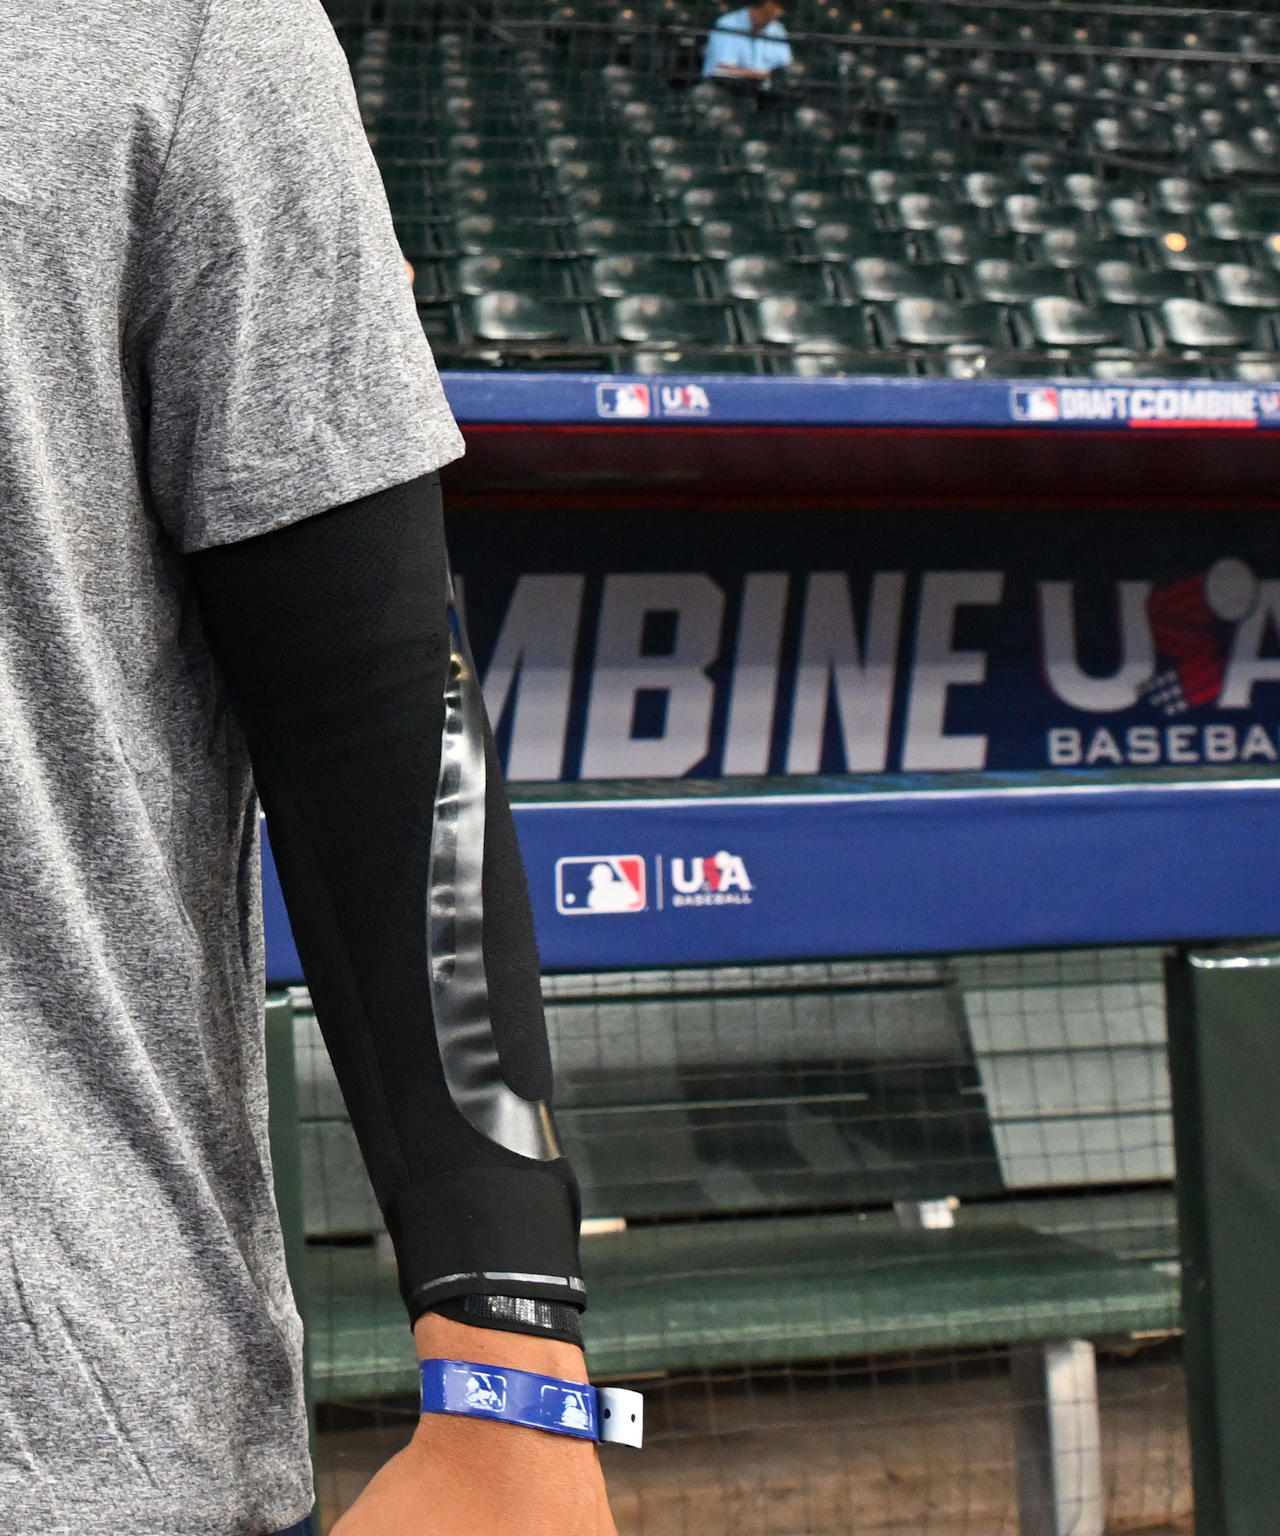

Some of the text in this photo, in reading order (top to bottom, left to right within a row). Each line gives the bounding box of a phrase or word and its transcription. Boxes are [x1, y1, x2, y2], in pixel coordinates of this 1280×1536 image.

[1060, 388, 1129, 420] DRAFT
[1128, 388, 1258, 421] COMBINE
[1048, 724, 1280, 766] BASEBA
